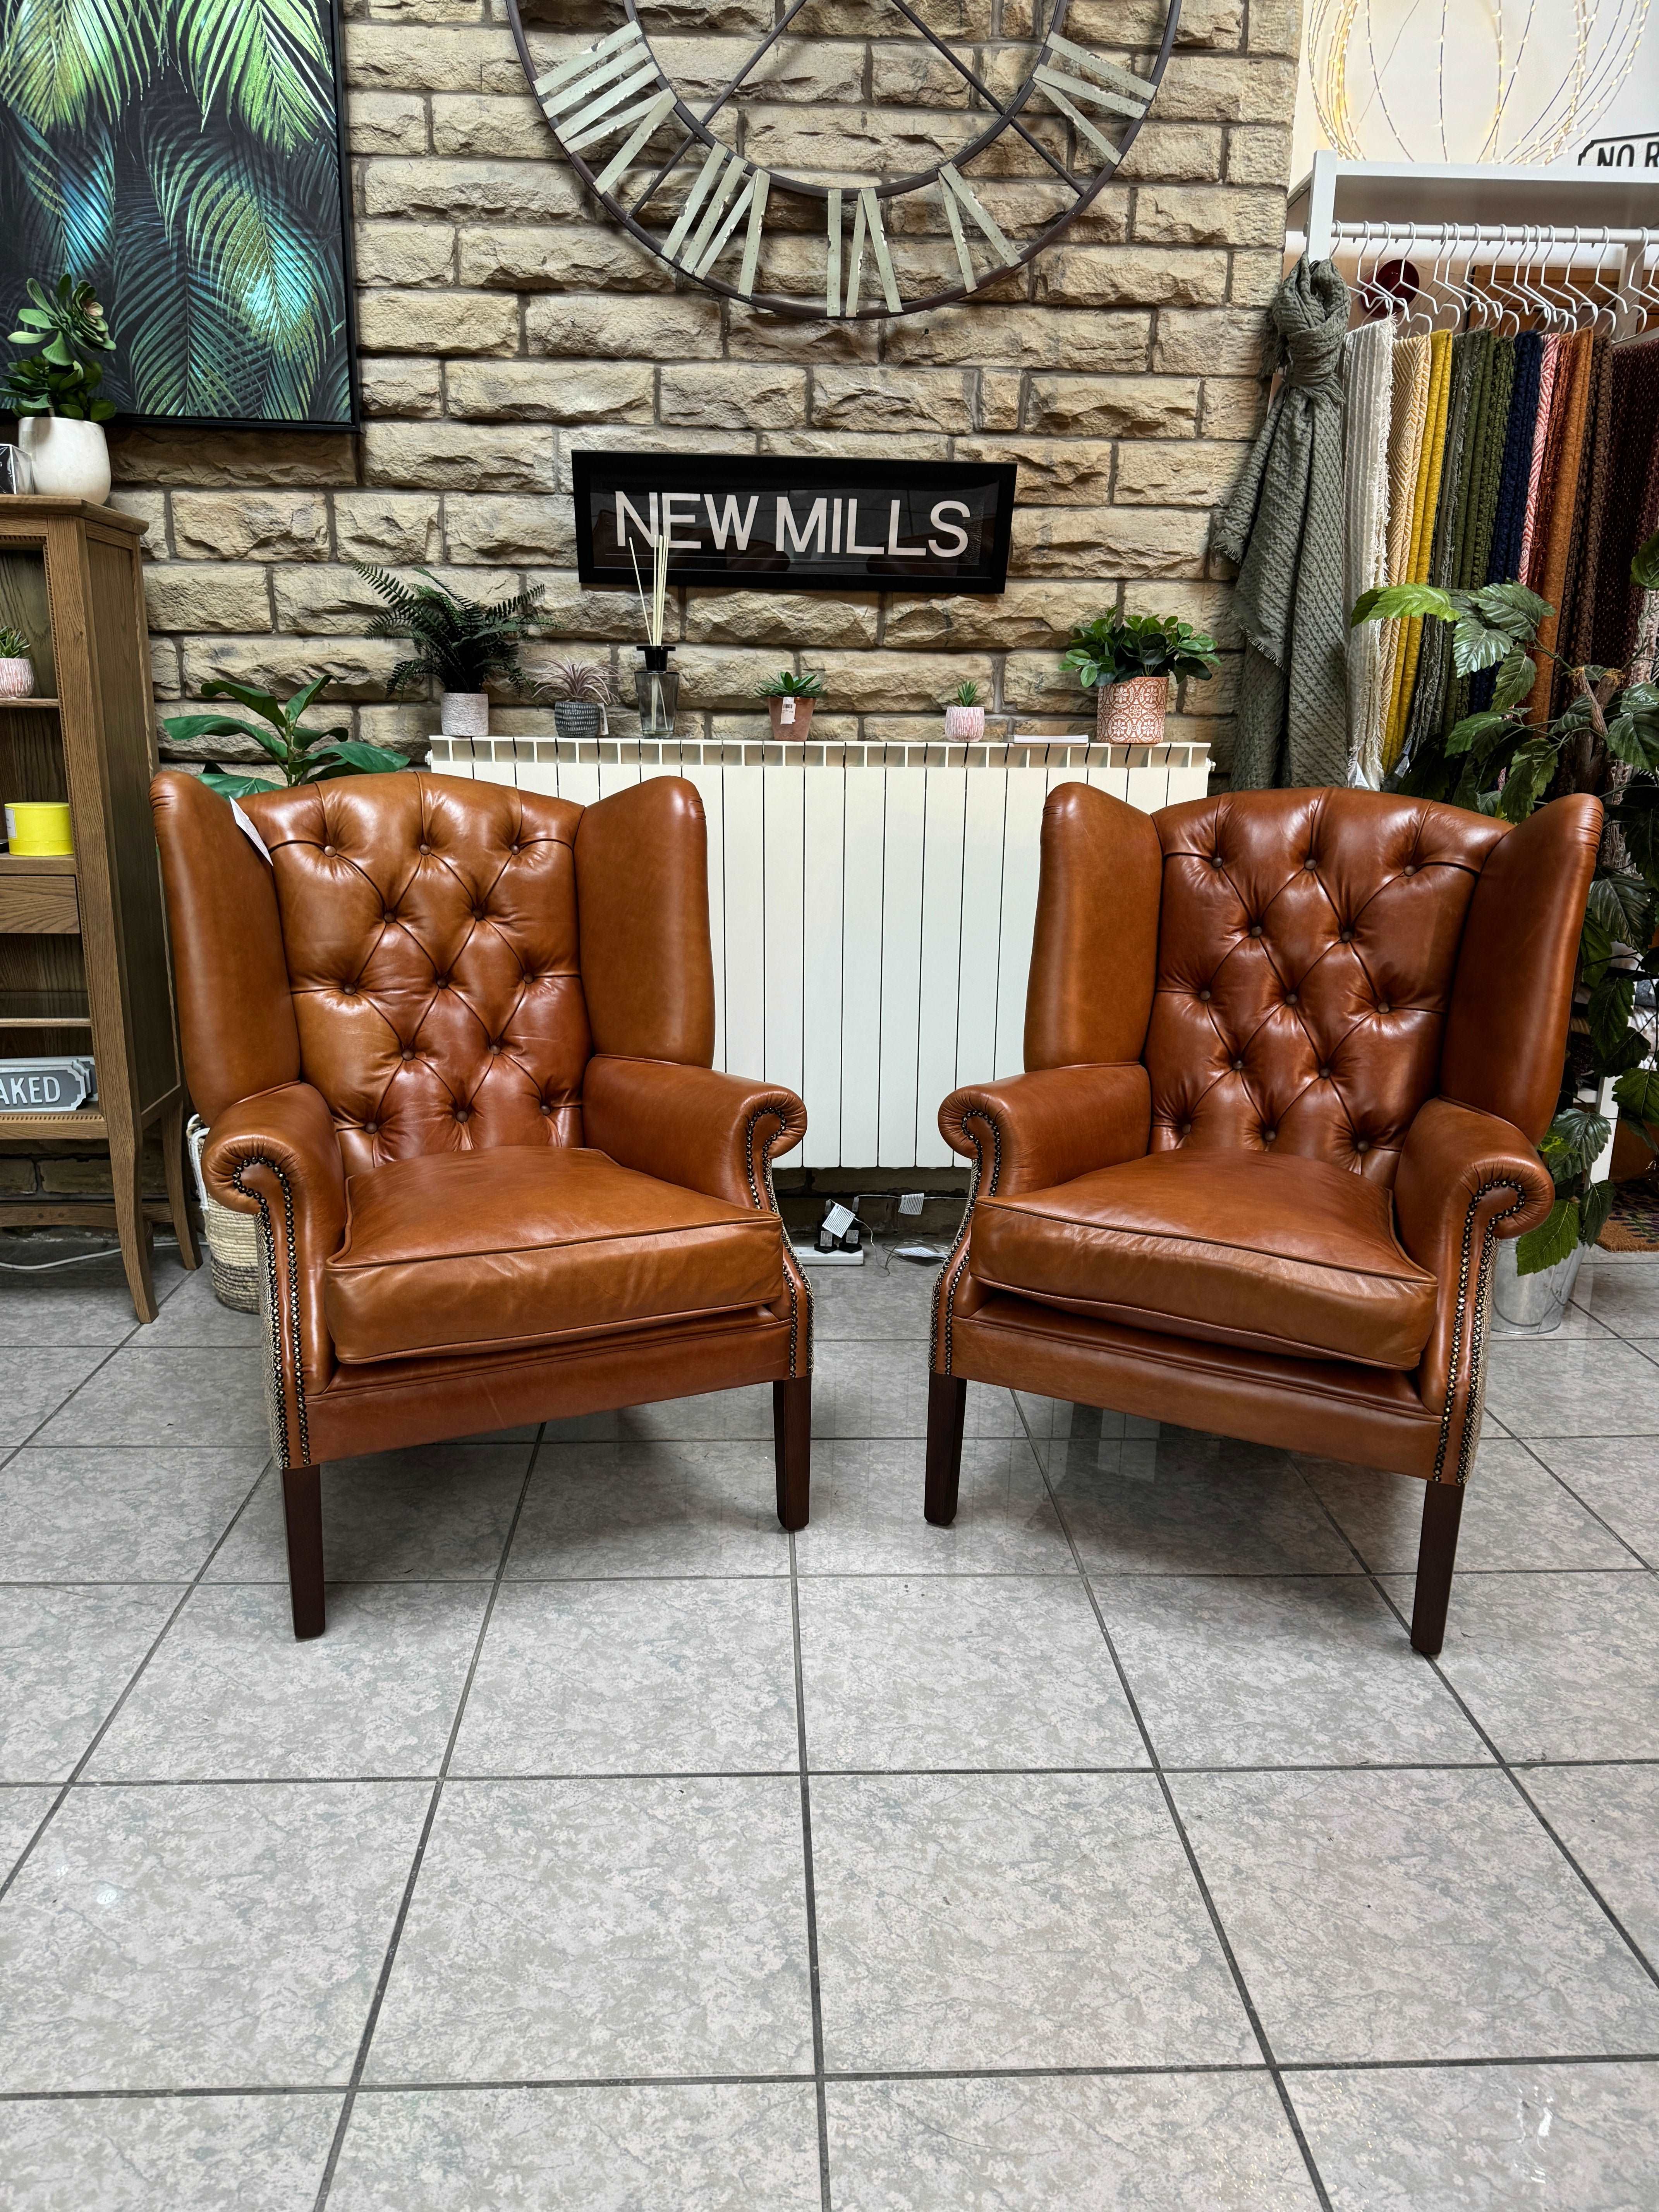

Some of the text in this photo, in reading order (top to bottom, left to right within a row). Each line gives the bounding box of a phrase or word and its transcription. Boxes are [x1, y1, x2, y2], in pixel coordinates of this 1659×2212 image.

[1597, 144, 1634, 167] NO
[615, 491, 970, 558] NEW MILLS
